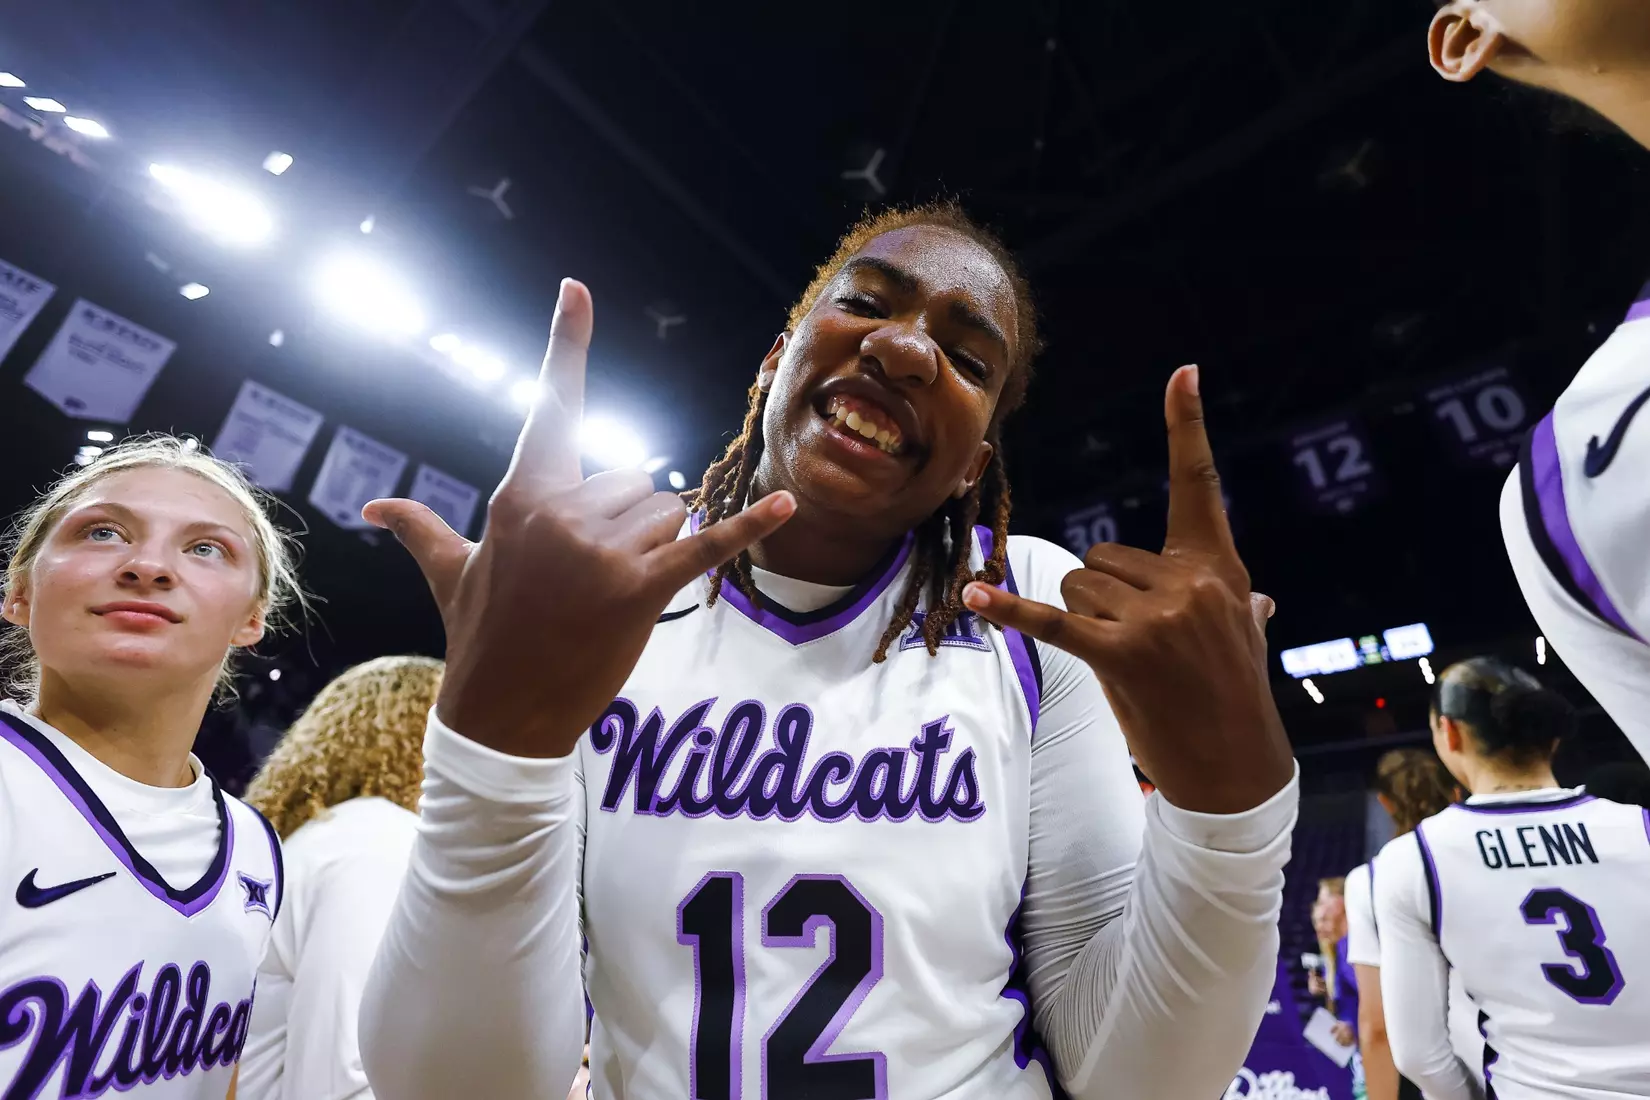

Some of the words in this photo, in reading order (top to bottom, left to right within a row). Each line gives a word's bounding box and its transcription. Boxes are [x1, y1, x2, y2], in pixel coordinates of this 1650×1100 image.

[1293, 434, 1373, 488] 12
[1435, 383, 1525, 442] 10
[590, 696, 987, 823] Wildcats
[1476, 822, 1599, 869] GLENN
[676, 870, 888, 1100] 12
[1520, 887, 1626, 1005] 3
[0, 960, 252, 1100] Wildca
